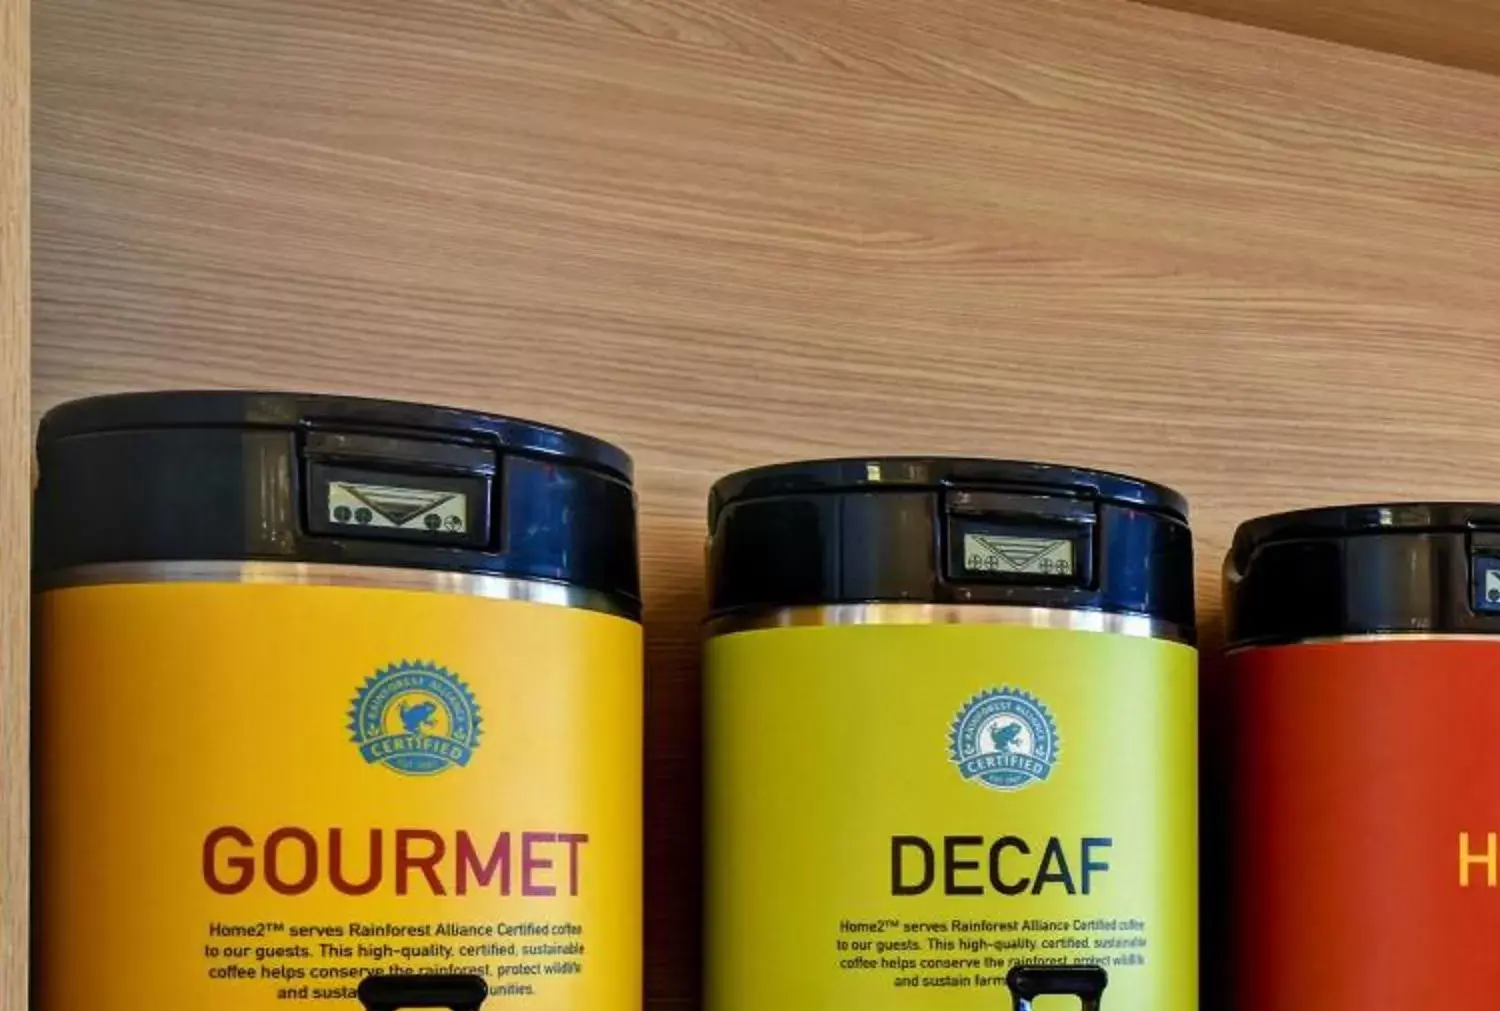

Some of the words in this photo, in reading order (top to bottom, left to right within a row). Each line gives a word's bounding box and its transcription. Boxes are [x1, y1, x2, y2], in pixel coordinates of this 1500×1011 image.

[371, 738, 463, 760] CERTIFIED
[967, 754, 1044, 773] CERTIFIED
[203, 826, 589, 896] GOURMET
[891, 835, 1113, 895] DECAF
[289, 925, 344, 937] serves
[349, 922, 431, 937] Rainforest
[435, 922, 493, 937] Alliance
[497, 922, 549, 937] Certified
[903, 922, 948, 933] serves
[951, 919, 1018, 933] Rainforest
[1021, 919, 1070, 932] Alliance
[1073, 919, 1117, 931] Certified
[204, 943, 219, 958] to
[223, 946, 250, 958] our
[255, 944, 314, 961] guests.
[318, 943, 353, 958] This
[522, 942, 585, 956] sustainable
[836, 939, 849, 951] to
[851, 941, 872, 951] our
[927, 937, 956, 951] This
[208, 964, 257, 979] coffee
[261, 964, 305, 982] helps
[310, 966, 385, 979] conserve
[497, 962, 541, 978] protect
[840, 956, 878, 969] coffee
[881, 956, 917, 971] helps
[919, 958, 981, 969] conserve
[984, 956, 1005, 968] the
[893, 974, 919, 987] and
[922, 974, 971, 987] sustain
[277, 985, 309, 1000] and
[313, 984, 359, 1000] susta
